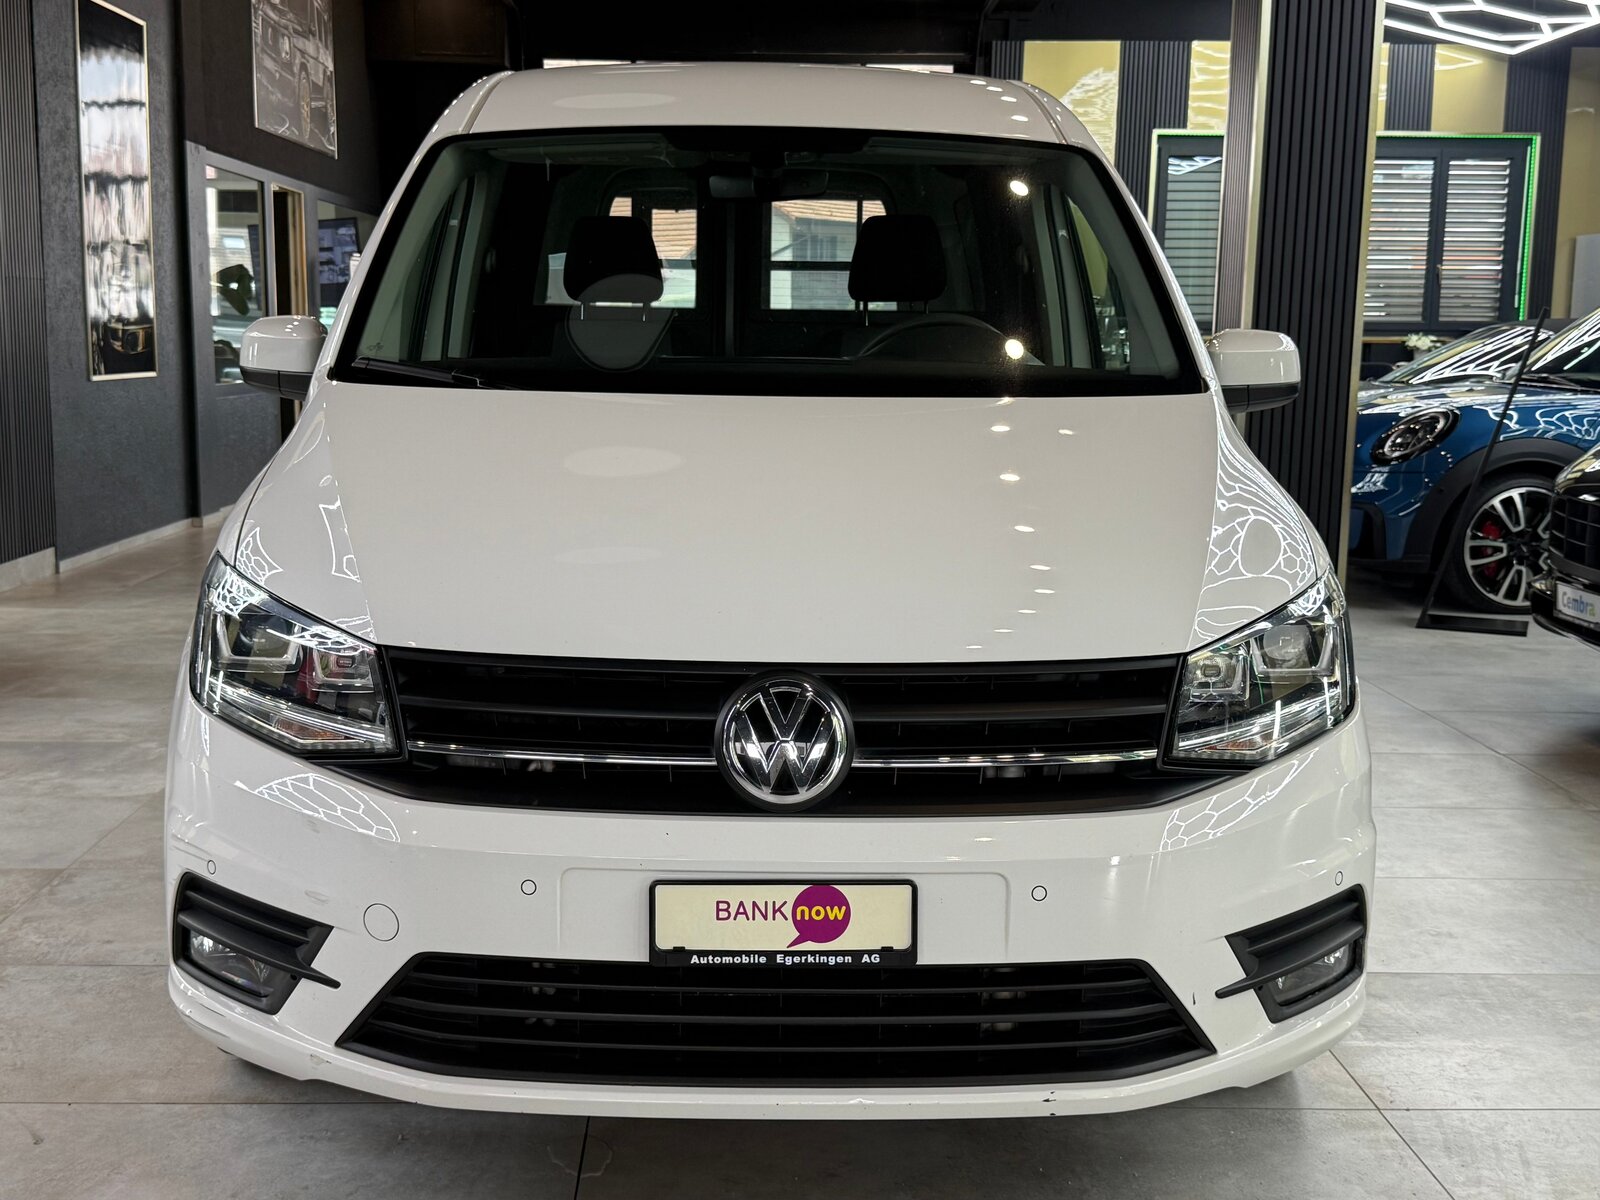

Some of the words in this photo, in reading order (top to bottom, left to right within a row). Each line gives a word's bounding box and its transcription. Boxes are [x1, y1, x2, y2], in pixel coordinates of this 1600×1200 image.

[1562, 591, 1596, 617] Cembra
[715, 900, 789, 921] BANK
[796, 905, 847, 921] now
[690, 954, 767, 964] Automobile
[776, 954, 852, 965] Egerkingen
[861, 954, 880, 964] AG
